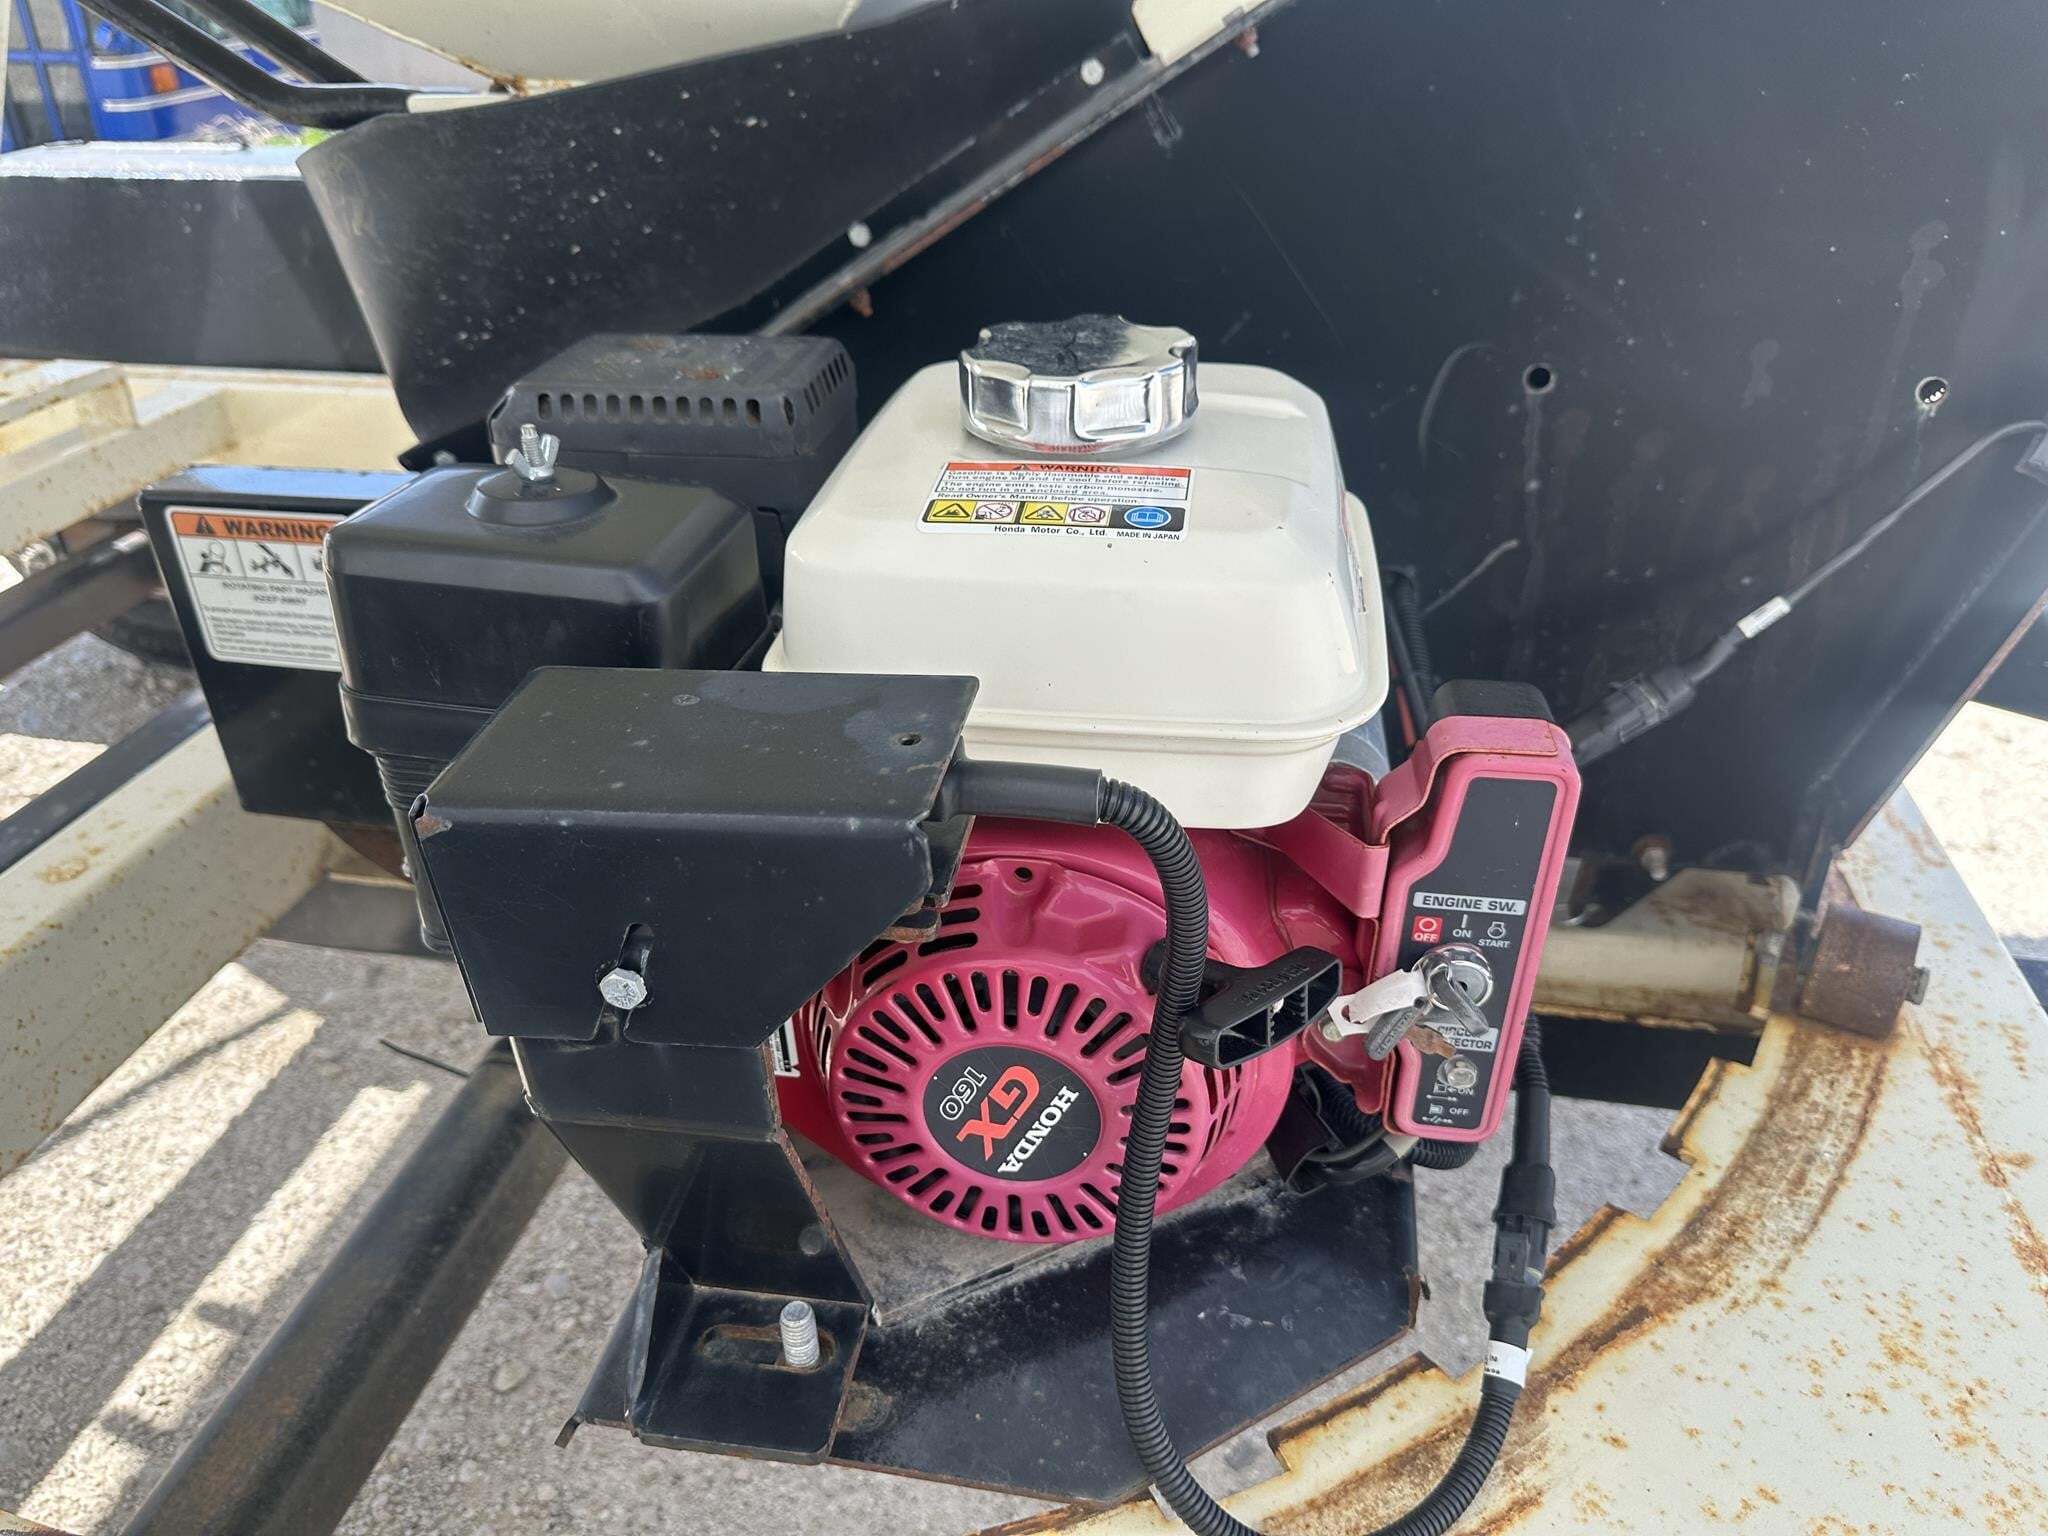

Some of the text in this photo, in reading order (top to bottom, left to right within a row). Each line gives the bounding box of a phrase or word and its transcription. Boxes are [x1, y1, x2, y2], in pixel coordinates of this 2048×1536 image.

[1040, 464, 1120, 473] WARNING
[1107, 486, 1162, 494] monoxide.
[222, 518, 330, 539] WARNING
[994, 525, 1025, 533] Honda
[1066, 528, 1085, 536] Co.,
[1117, 530, 1140, 538] MADE
[1153, 532, 1180, 541] JAPAN
[1422, 895, 1517, 912] ENGINE SW.
[1414, 928, 1511, 949] OFF ON START
[939, 1066, 988, 1120] 160
[1457, 1087, 1475, 1096] ON
[956, 1065, 1040, 1161] GX
[1449, 1107, 1470, 1116] OFF
[997, 1085, 1080, 1173] HONDA
